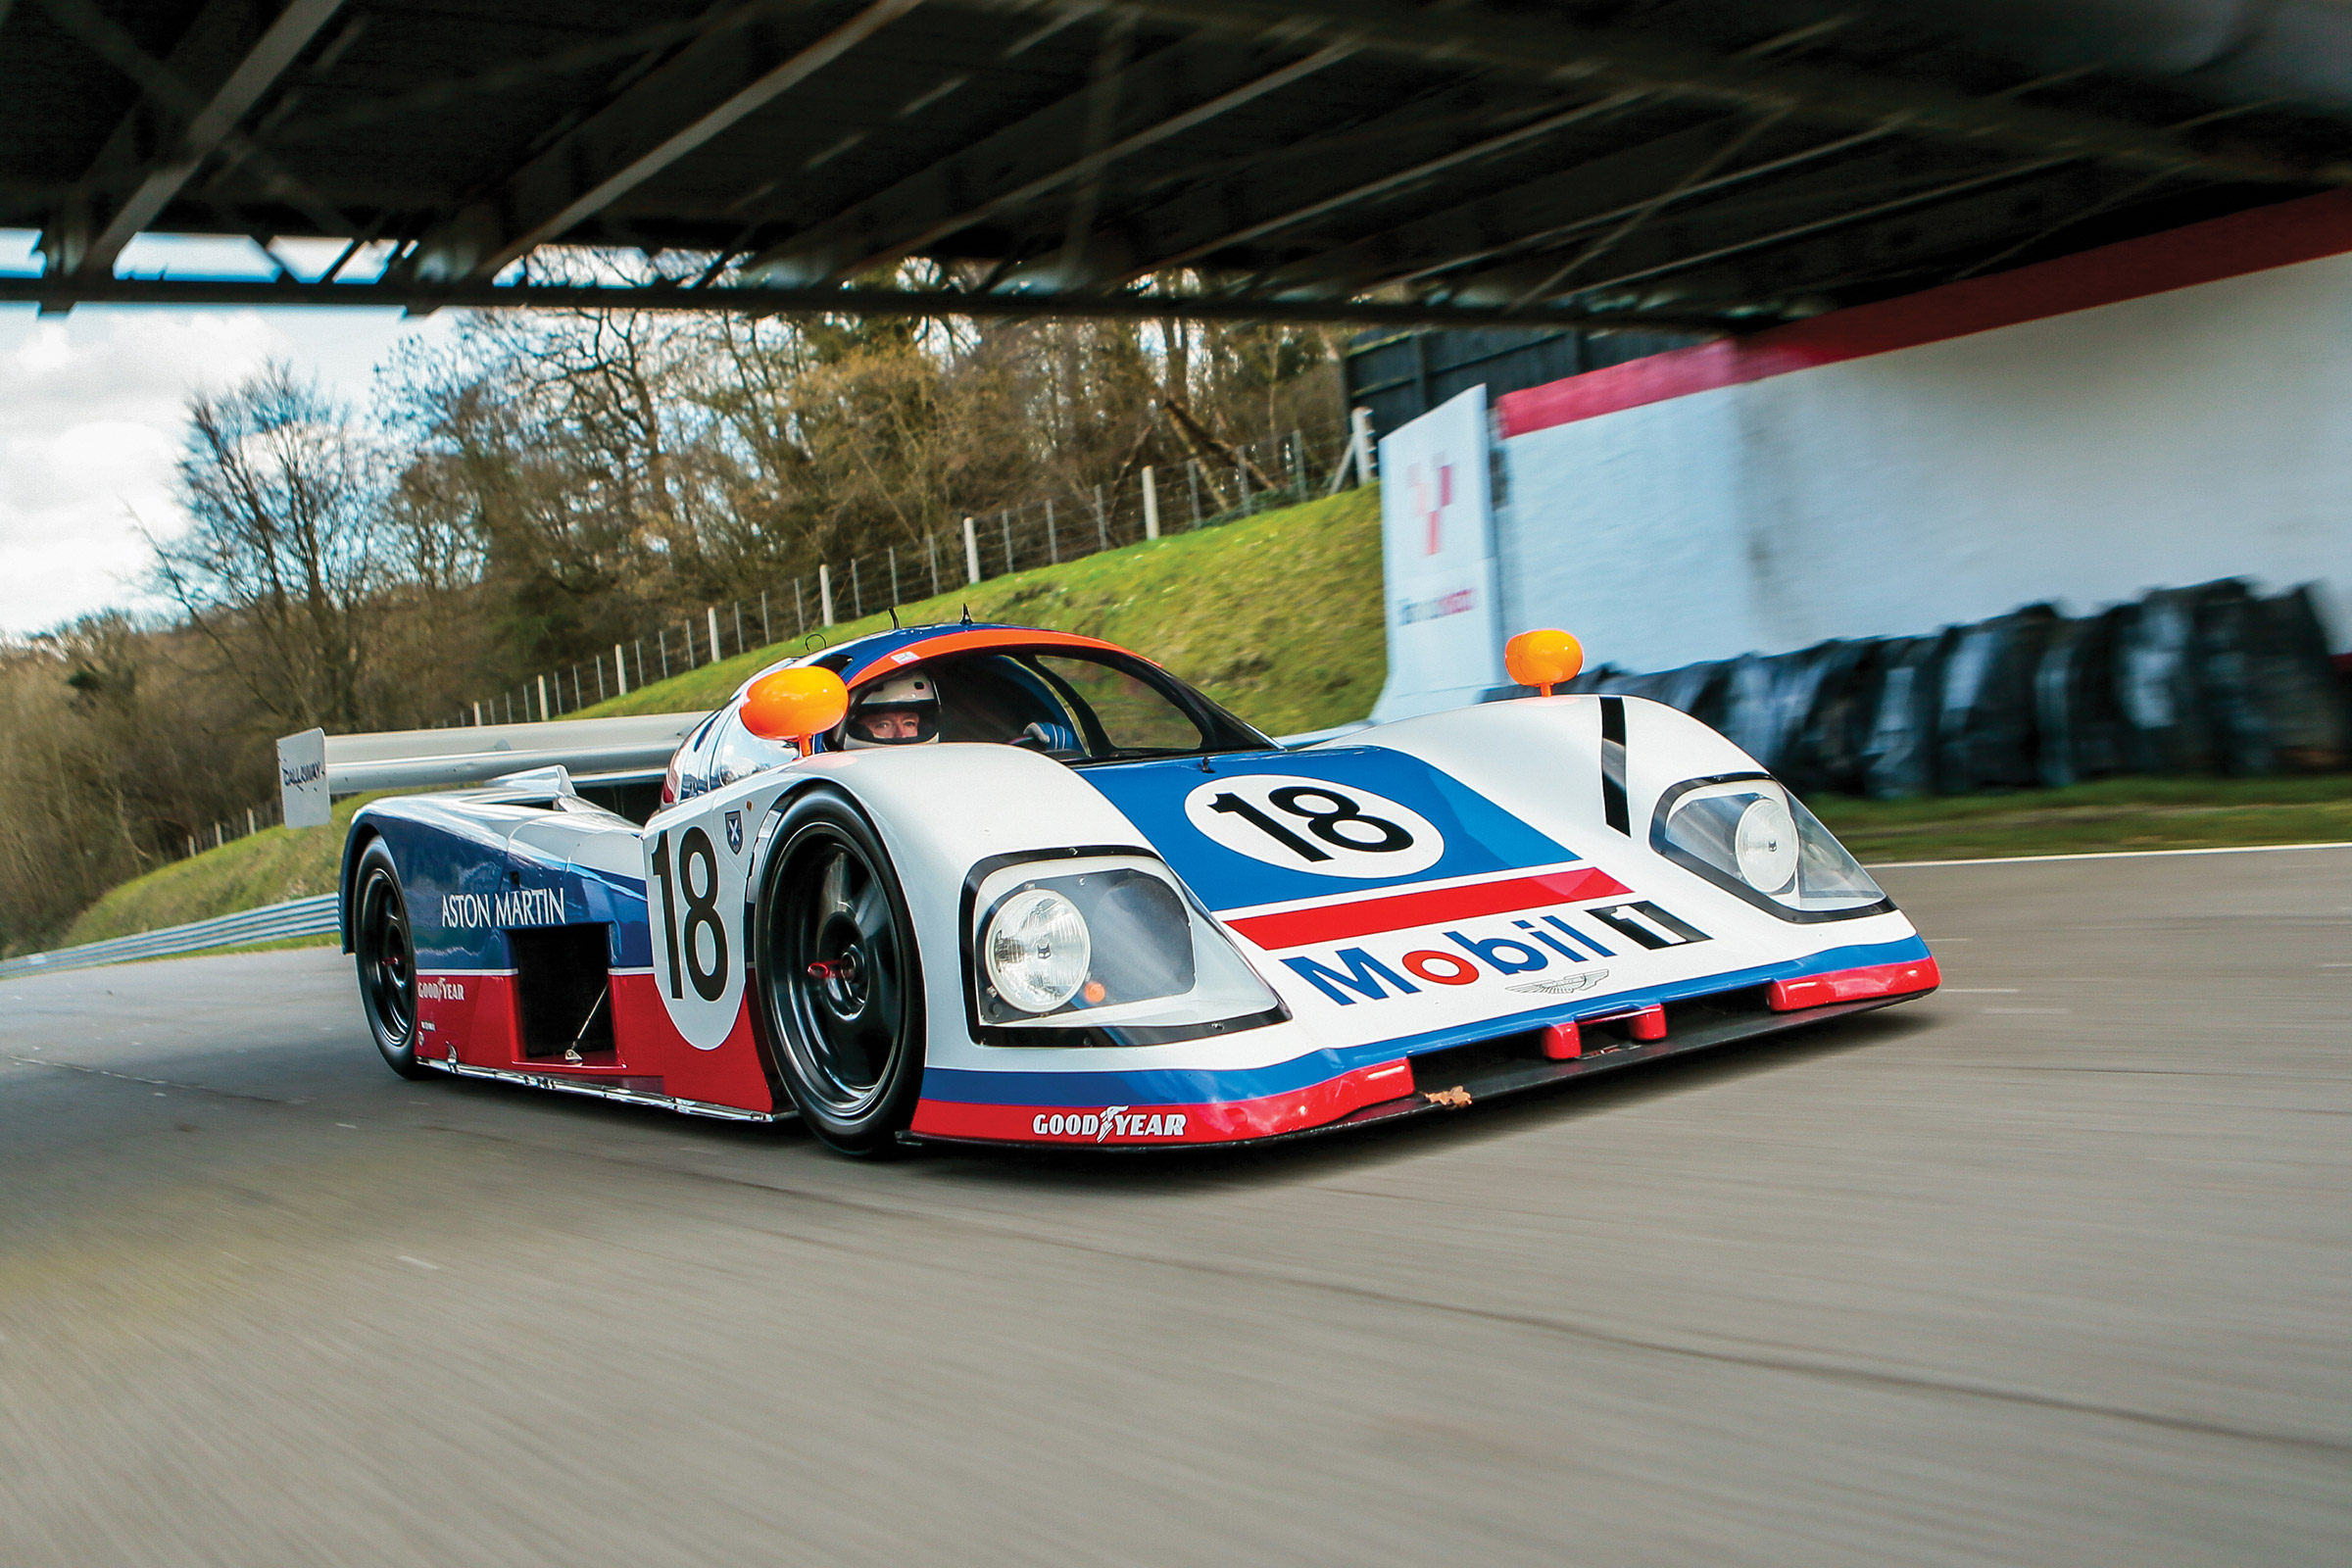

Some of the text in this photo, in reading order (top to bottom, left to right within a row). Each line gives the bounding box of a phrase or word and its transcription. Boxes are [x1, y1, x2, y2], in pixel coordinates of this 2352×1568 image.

[1206, 785, 1414, 862] 18
[441, 887, 565, 928] ASTON MARTIN
[651, 826, 729, 1002] 18
[1279, 914, 1618, 1006] Mobil
[417, 981, 466, 1001] GOODYEAR
[1033, 1111, 1187, 1138] GOODYEAR
